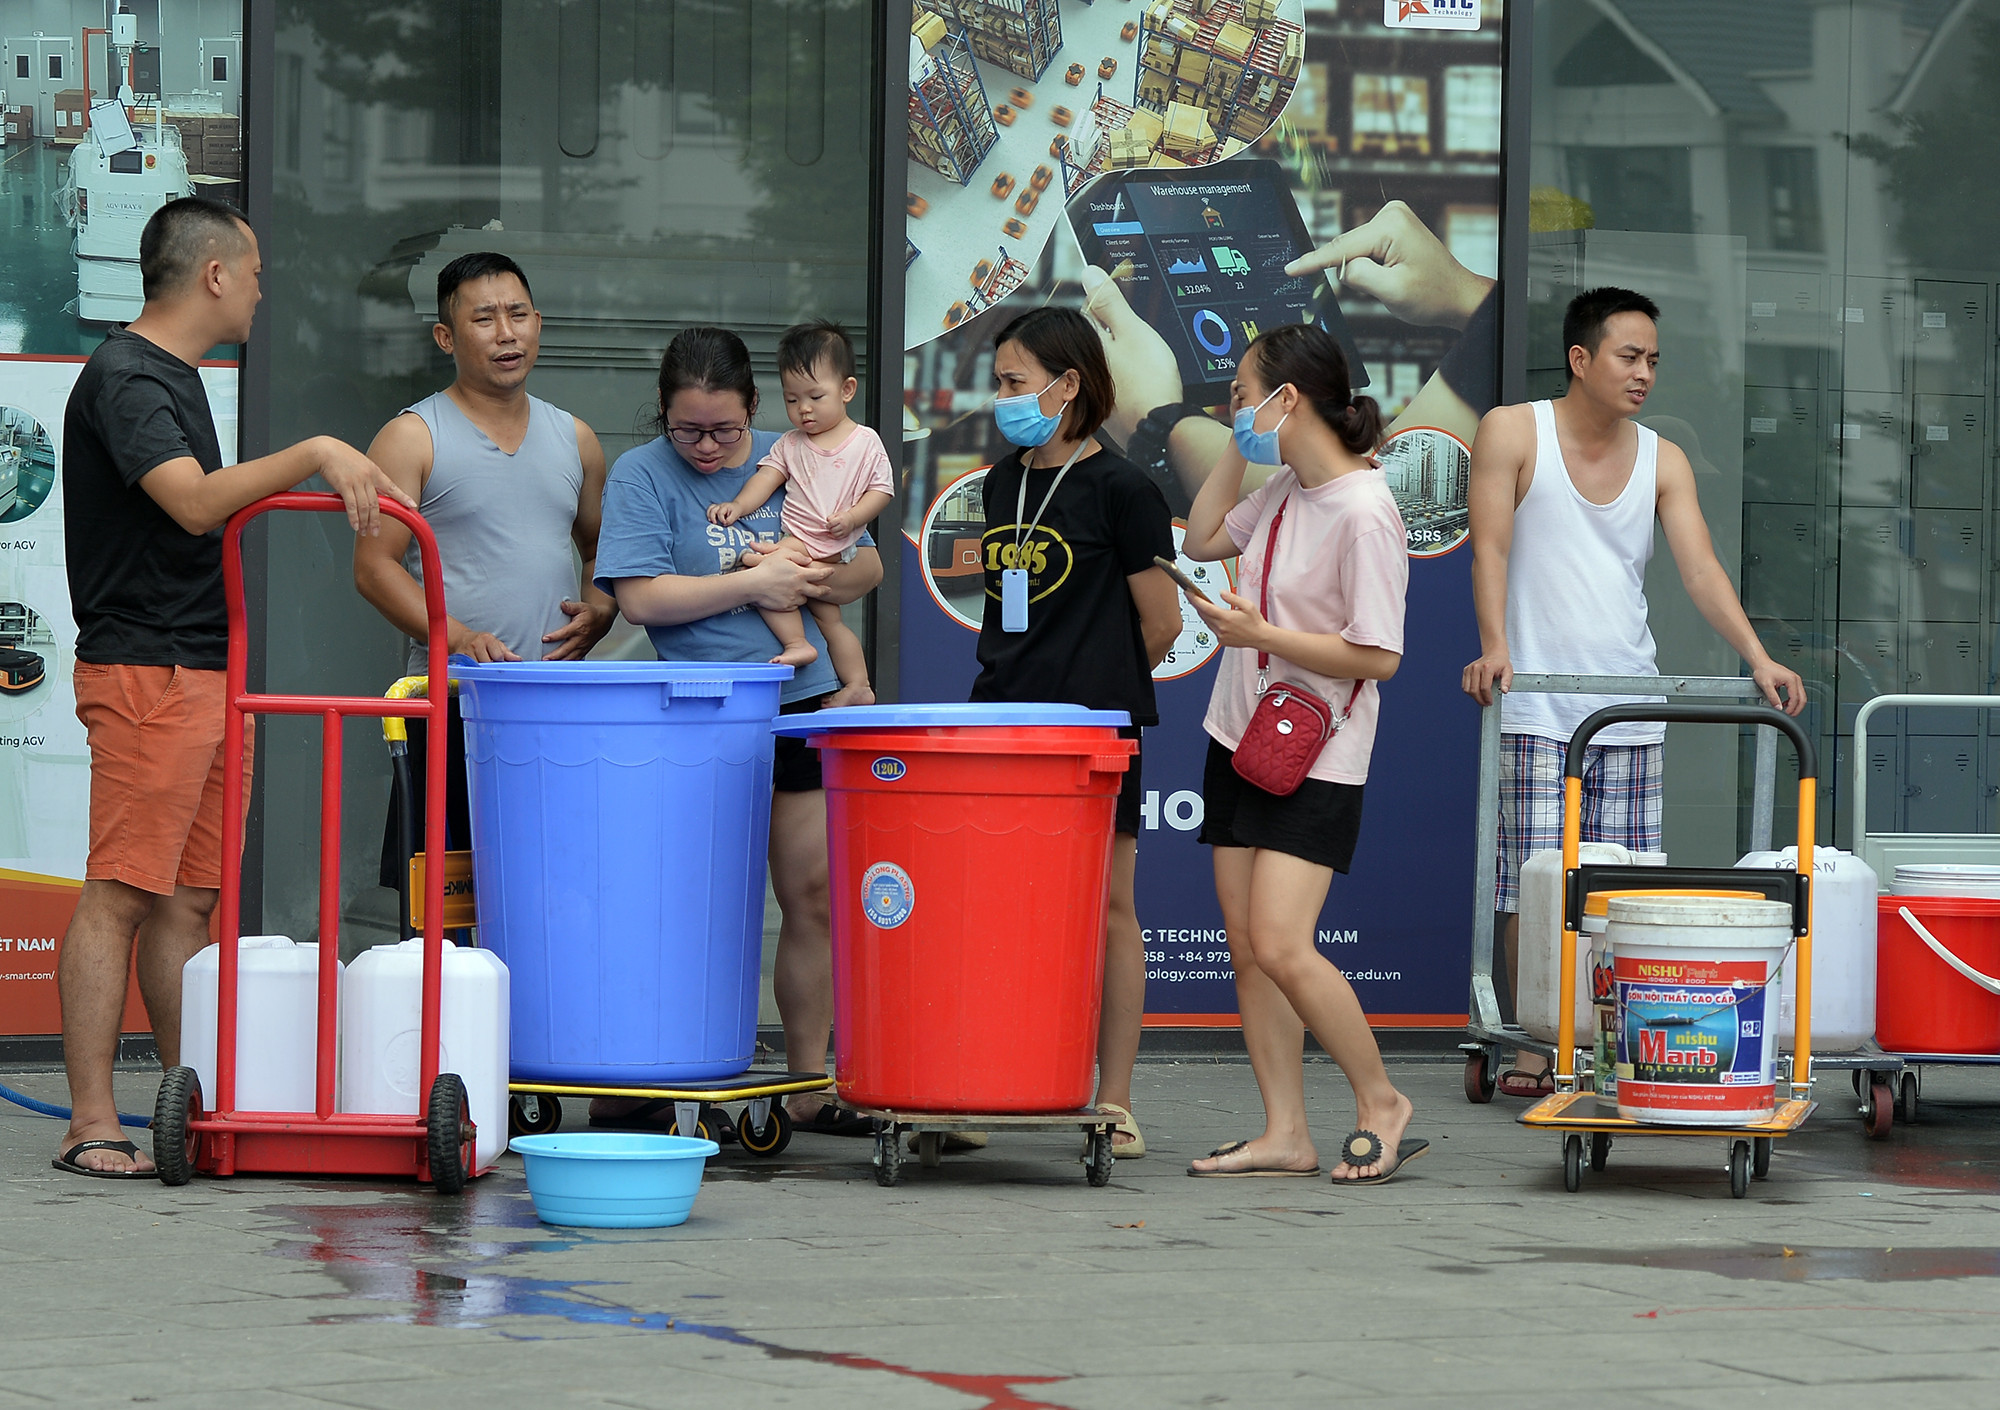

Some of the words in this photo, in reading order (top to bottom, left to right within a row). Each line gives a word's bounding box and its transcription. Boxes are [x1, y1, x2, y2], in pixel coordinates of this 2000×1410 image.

[1433, 9, 1473, 17] Technology
[1150, 185, 1199, 196] Warehouse
[1199, 183, 1252, 197] management
[1090, 201, 1126, 212] Dashbod
[1185, 284, 1212, 295] 32.04%
[1235, 282, 1245, 290] 23
[1215, 357, 1236, 370] 25%
[1406, 529, 1442, 542] ASRS
[0, 542, 12, 550] or
[13, 540, 36, 550] AGV
[985, 540, 1050, 575] 1985
[22, 736, 45, 746] AGV
[875, 762, 902, 776] 120L
[871, 866, 890, 877] LONG
[891, 868, 911, 900] PLASTIC
[1157, 929, 1227, 943] TECHNO
[1318, 930, 1358, 943] NAM
[17, 938, 55, 951] NAM
[1178, 951, 1203, 962] +84
[1206, 951, 1231, 962] 979
[1638, 964, 1684, 978] NISHU
[1645, 991, 1661, 1002] NỘI
[1663, 989, 1689, 1003] THẤT
[1691, 994, 1713, 1004] CAO
[1715, 990, 1736, 1004] CẤP
[1675, 1030, 1718, 1046] nishu
[1638, 1028, 1718, 1066] Marb
[1639, 1063, 1717, 1074] interior
